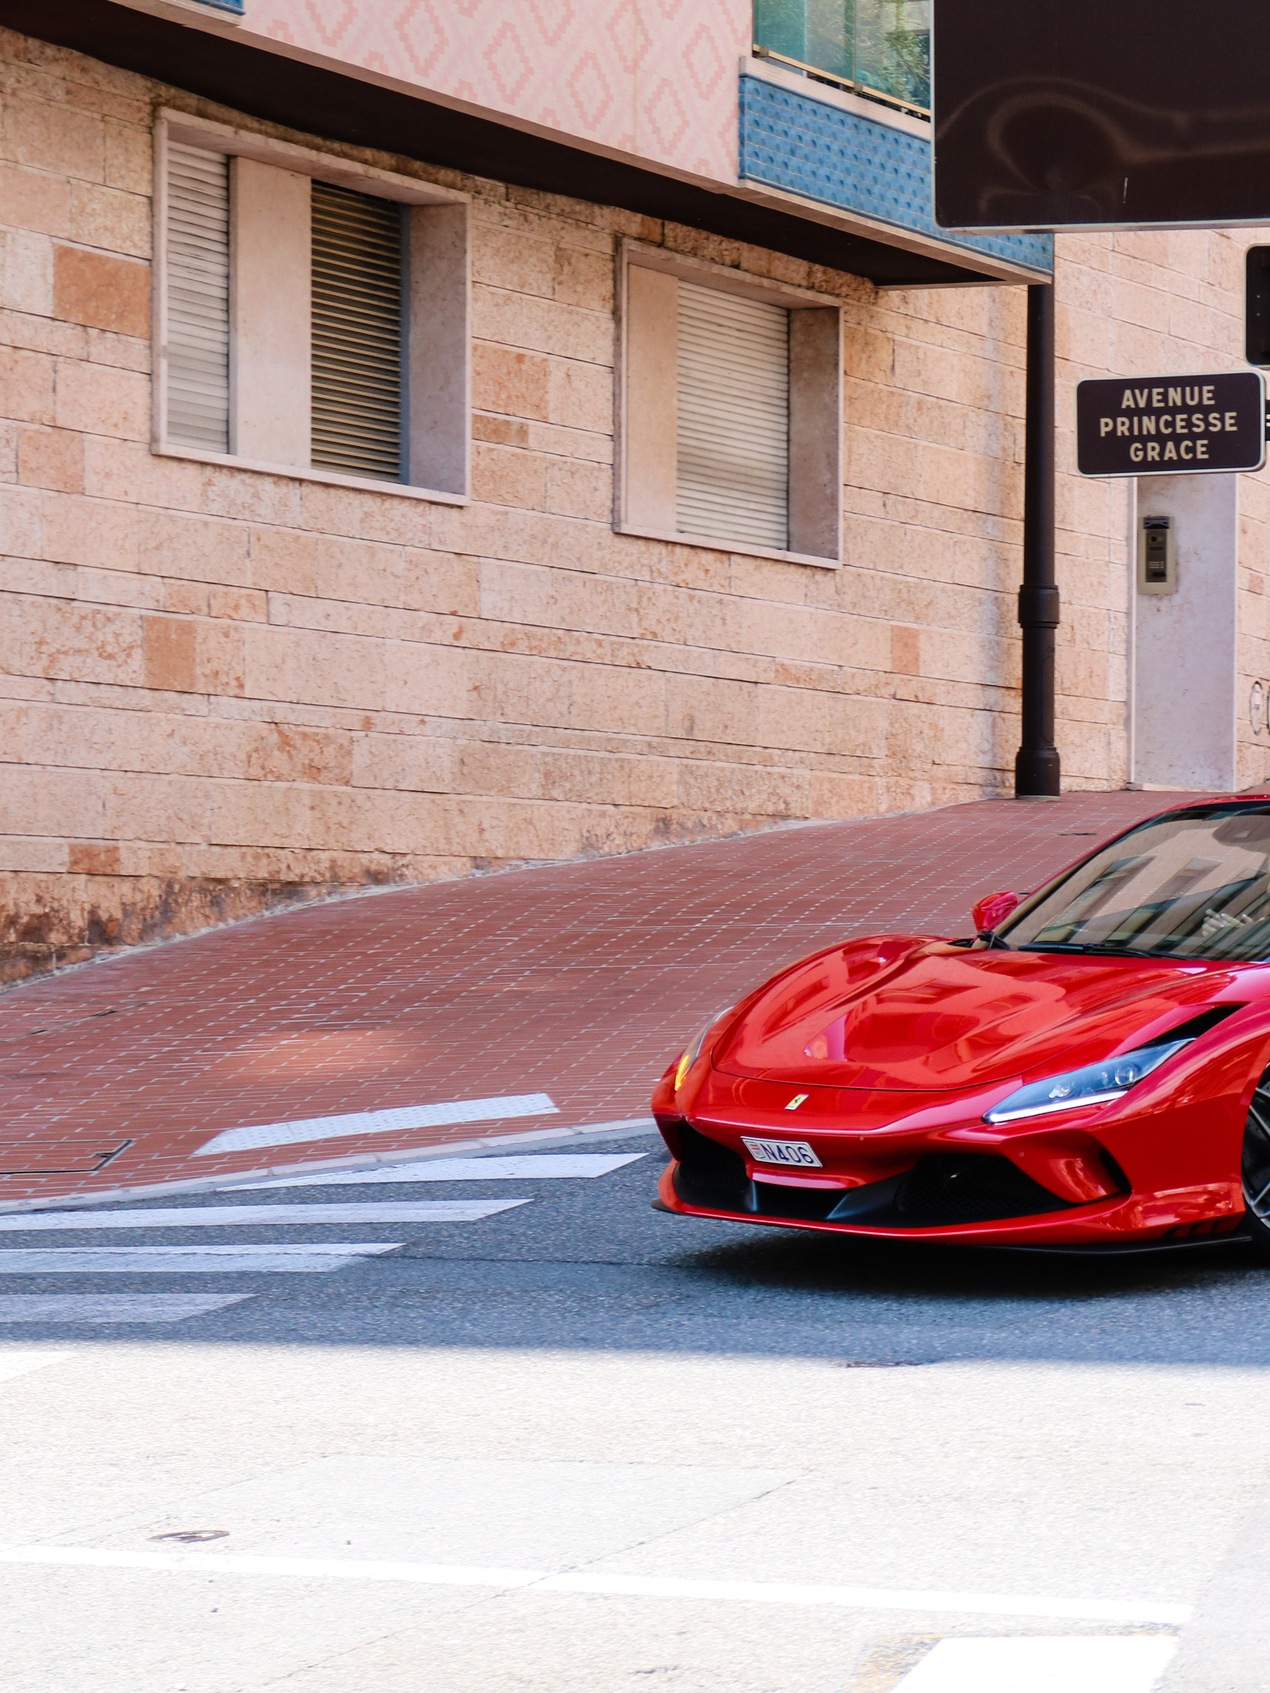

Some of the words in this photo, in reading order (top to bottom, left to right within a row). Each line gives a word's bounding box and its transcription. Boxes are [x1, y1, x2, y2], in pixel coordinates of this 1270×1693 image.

[1121, 385, 1215, 408] AVENUE
[1100, 412, 1238, 437] PRINCESSE
[1129, 440, 1209, 462] GRACE
[760, 1143, 814, 1164] N406
